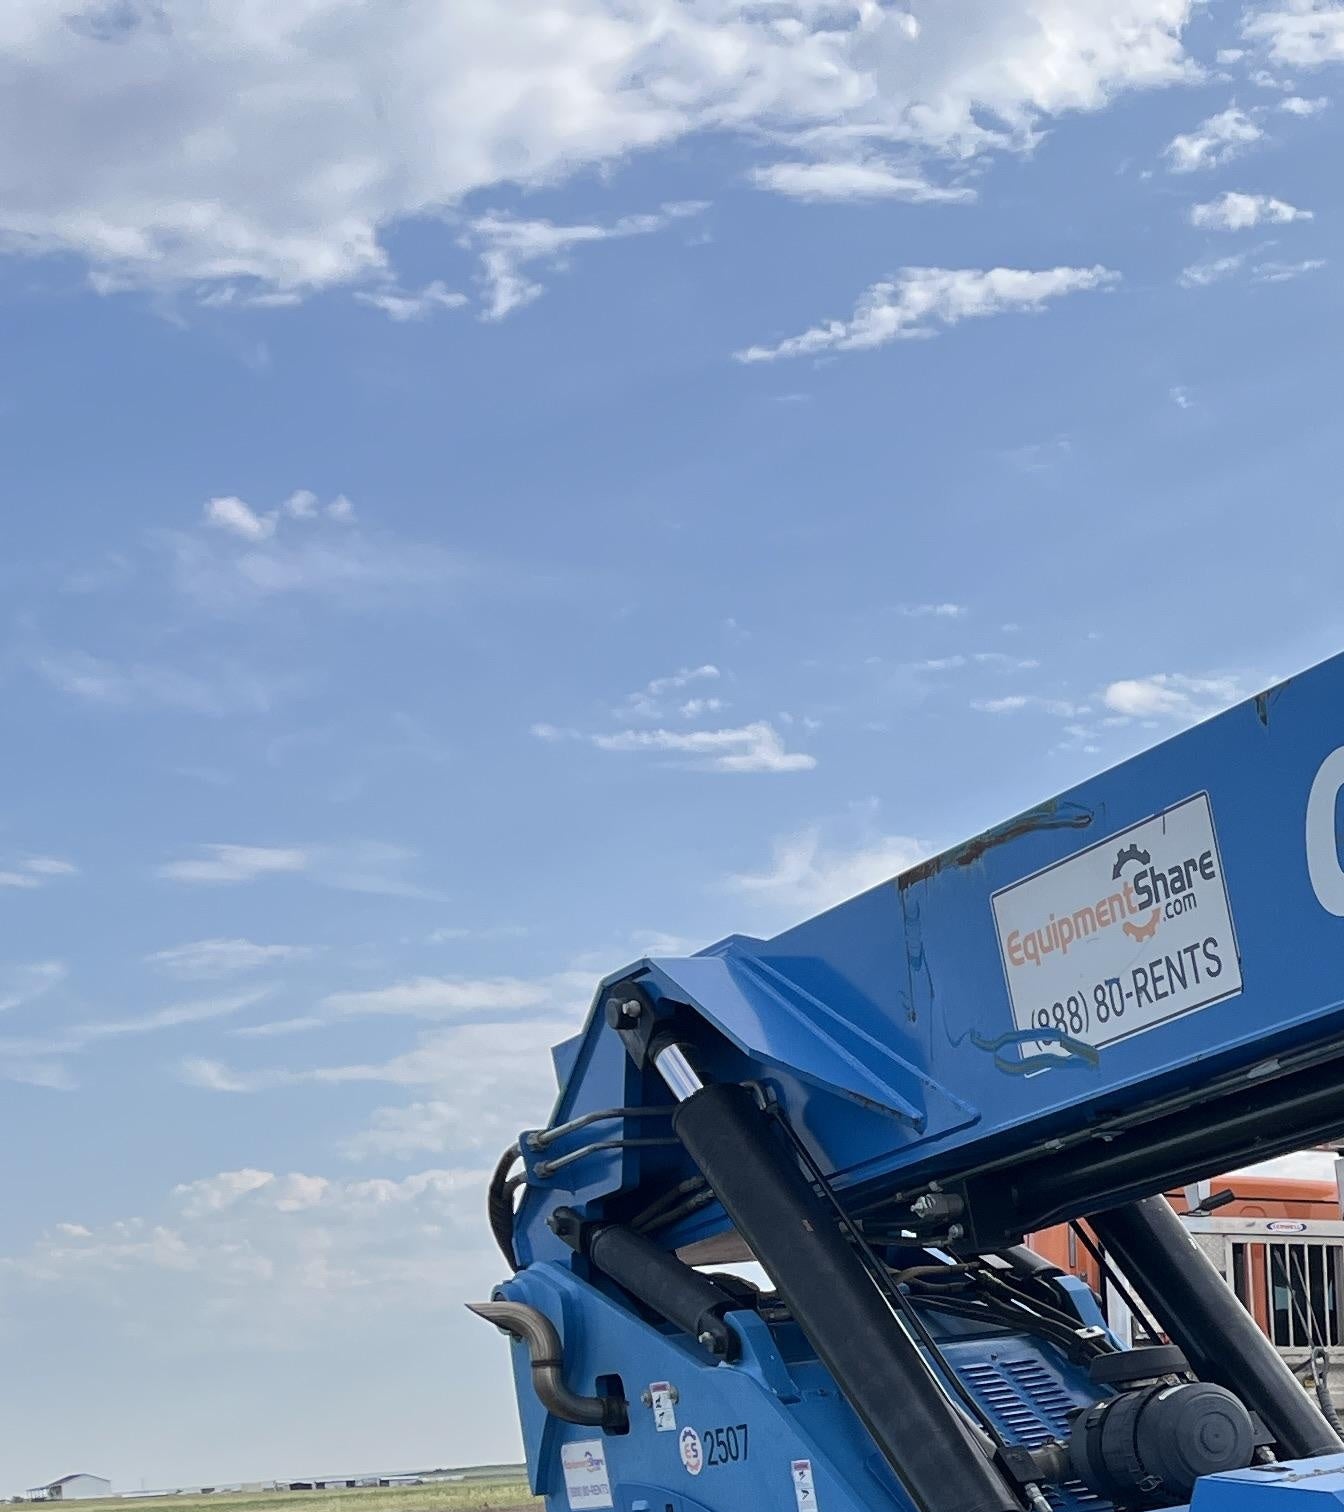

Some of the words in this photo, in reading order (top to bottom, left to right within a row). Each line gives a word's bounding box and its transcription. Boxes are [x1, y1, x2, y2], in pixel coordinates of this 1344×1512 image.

[1006, 850, 1216, 967] EquipmentShare
[1162, 892, 1198, 922] .com
[1093, 936, 1223, 1024] 80-RENTS
[703, 1424, 748, 1466] 2507
